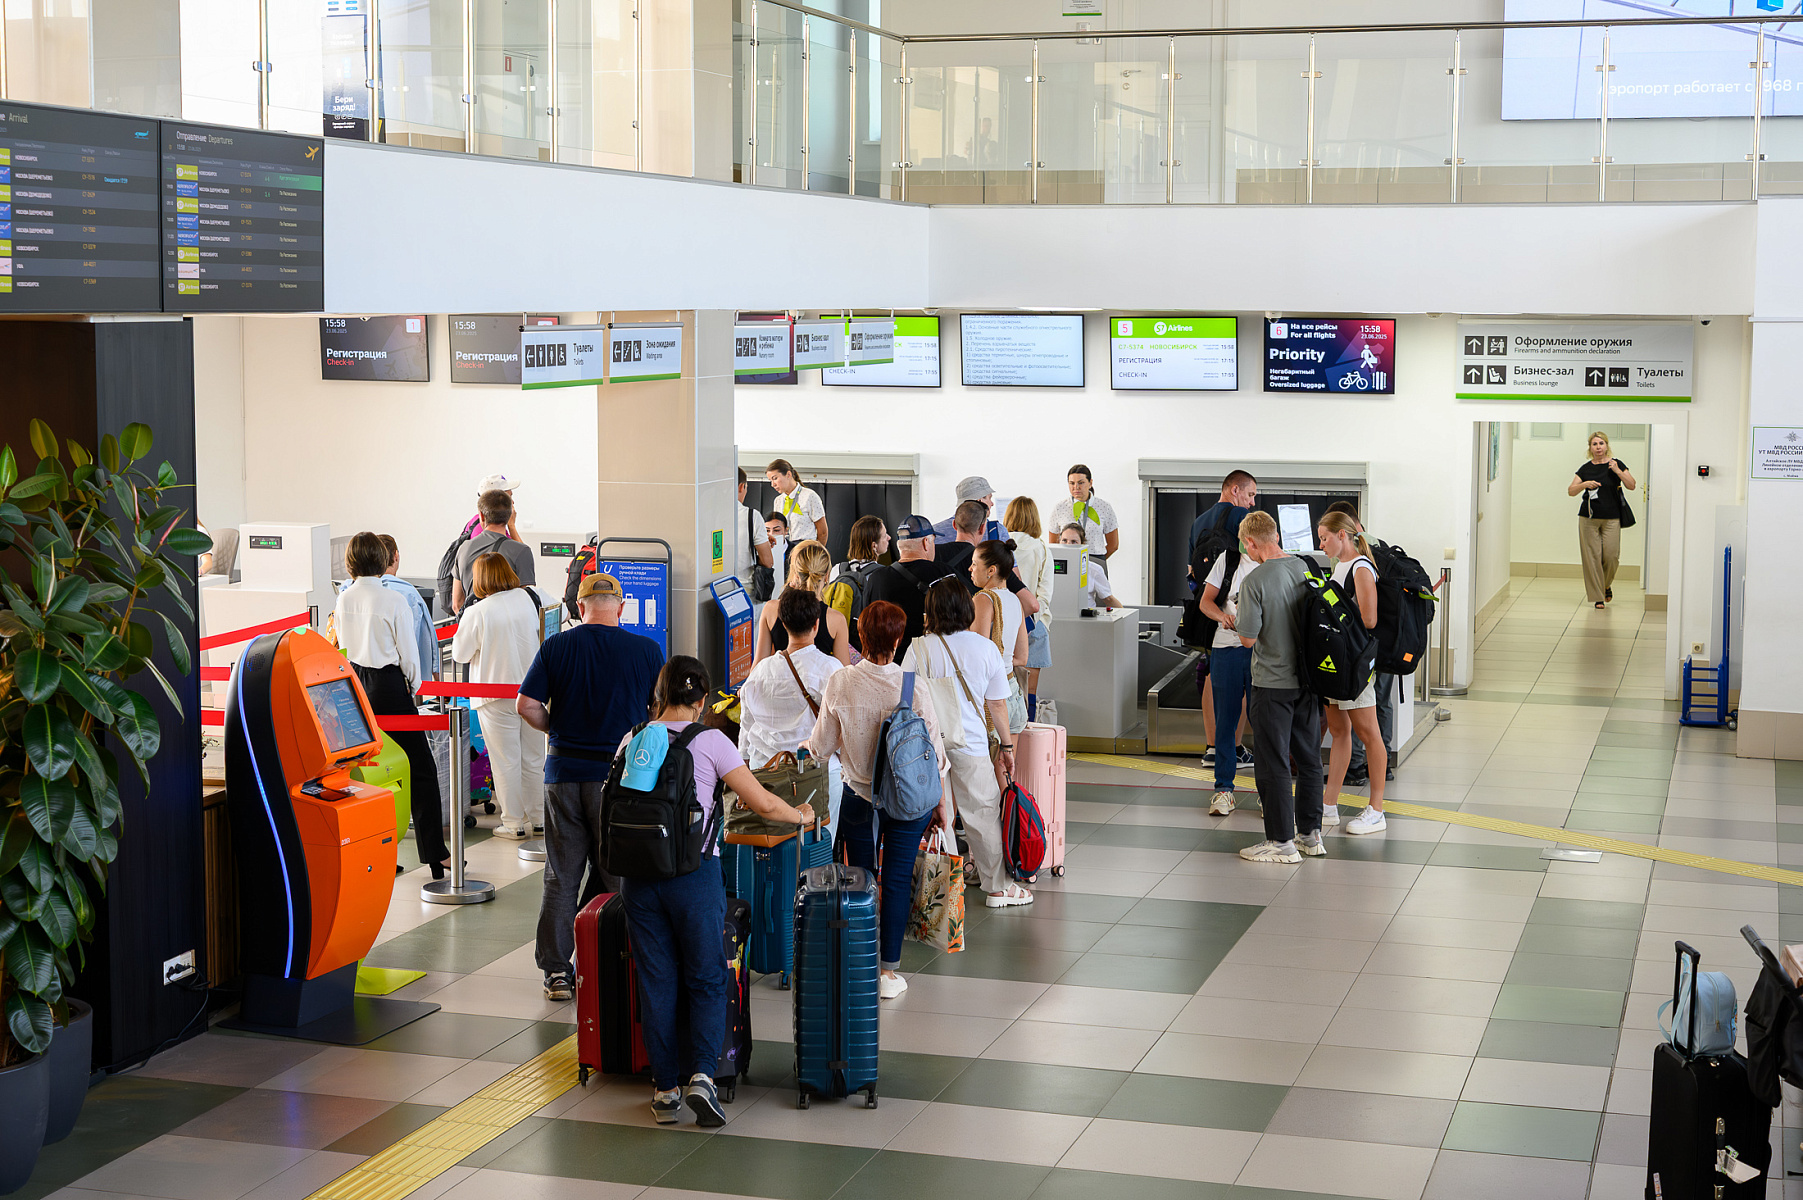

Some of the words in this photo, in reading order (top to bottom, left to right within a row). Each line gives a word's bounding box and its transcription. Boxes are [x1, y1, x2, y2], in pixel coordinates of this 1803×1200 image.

[1598, 83, 1670, 96] эропорт
[1674, 80, 1740, 96] работает
[1744, 84, 1753, 92] с
[1763, 80, 1792, 92] 968
[334, 96, 354, 104] Бери
[332, 103, 356, 112] заряд!
[8, 112, 28, 124] Arrival
[176, 131, 207, 142] Отправление
[208, 134, 233, 145] Departures
[325, 319, 346, 327] 15:58
[411, 322, 415, 330] 1
[1122, 324, 1128, 333] 5
[1276, 326, 1282, 335] 6
[646, 340, 655, 348] Зона
[656, 340, 676, 348] ожидания
[1515, 337, 1587, 347] Оформление
[1590, 338, 1632, 348] оружия
[326, 348, 387, 359] Регистрация
[573, 343, 593, 355] Туалеты
[456, 351, 518, 362] Регистрация
[1269, 348, 1326, 363] Priority
[1514, 365, 1574, 376] Бизнес-зал
[1637, 367, 1684, 378] Туалеты
